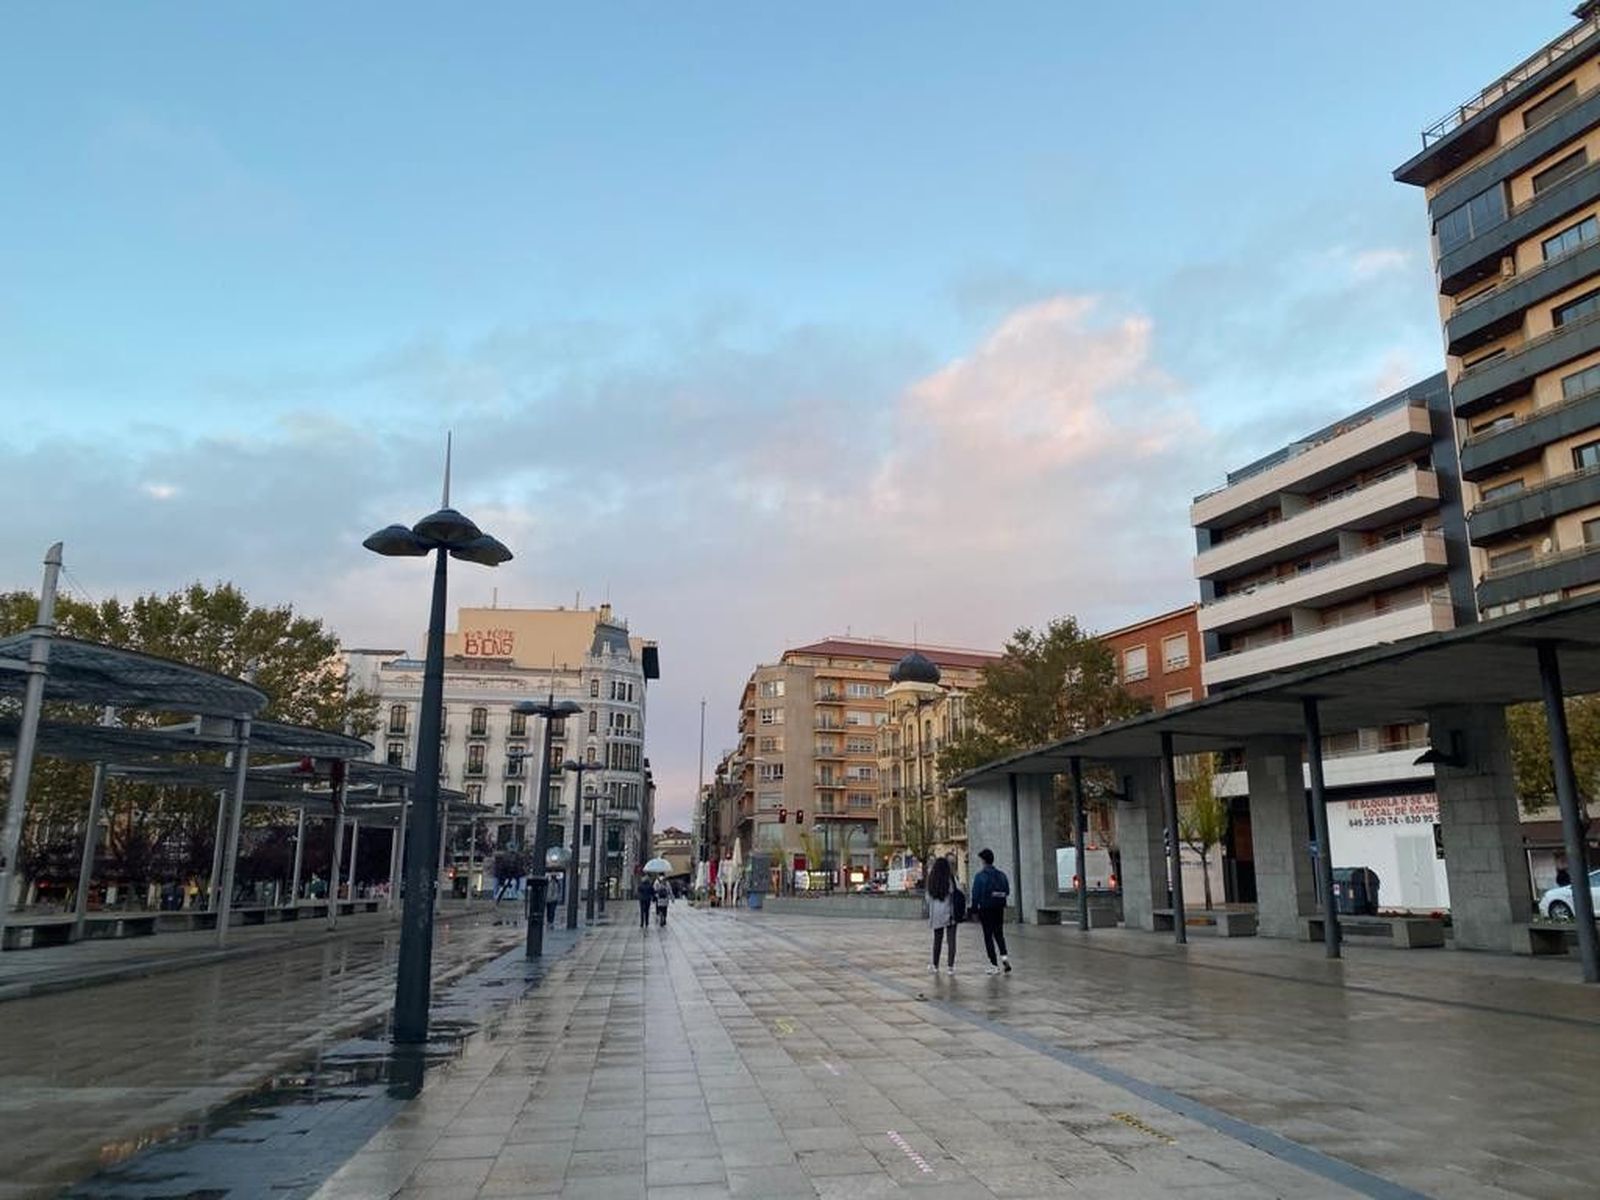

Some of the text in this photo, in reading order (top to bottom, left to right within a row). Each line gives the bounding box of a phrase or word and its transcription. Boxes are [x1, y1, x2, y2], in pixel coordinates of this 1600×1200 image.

[1360, 797, 1398, 809] ALQUILA
[1363, 806, 1393, 818] LOCAL
[1394, 806, 1407, 816] DE
